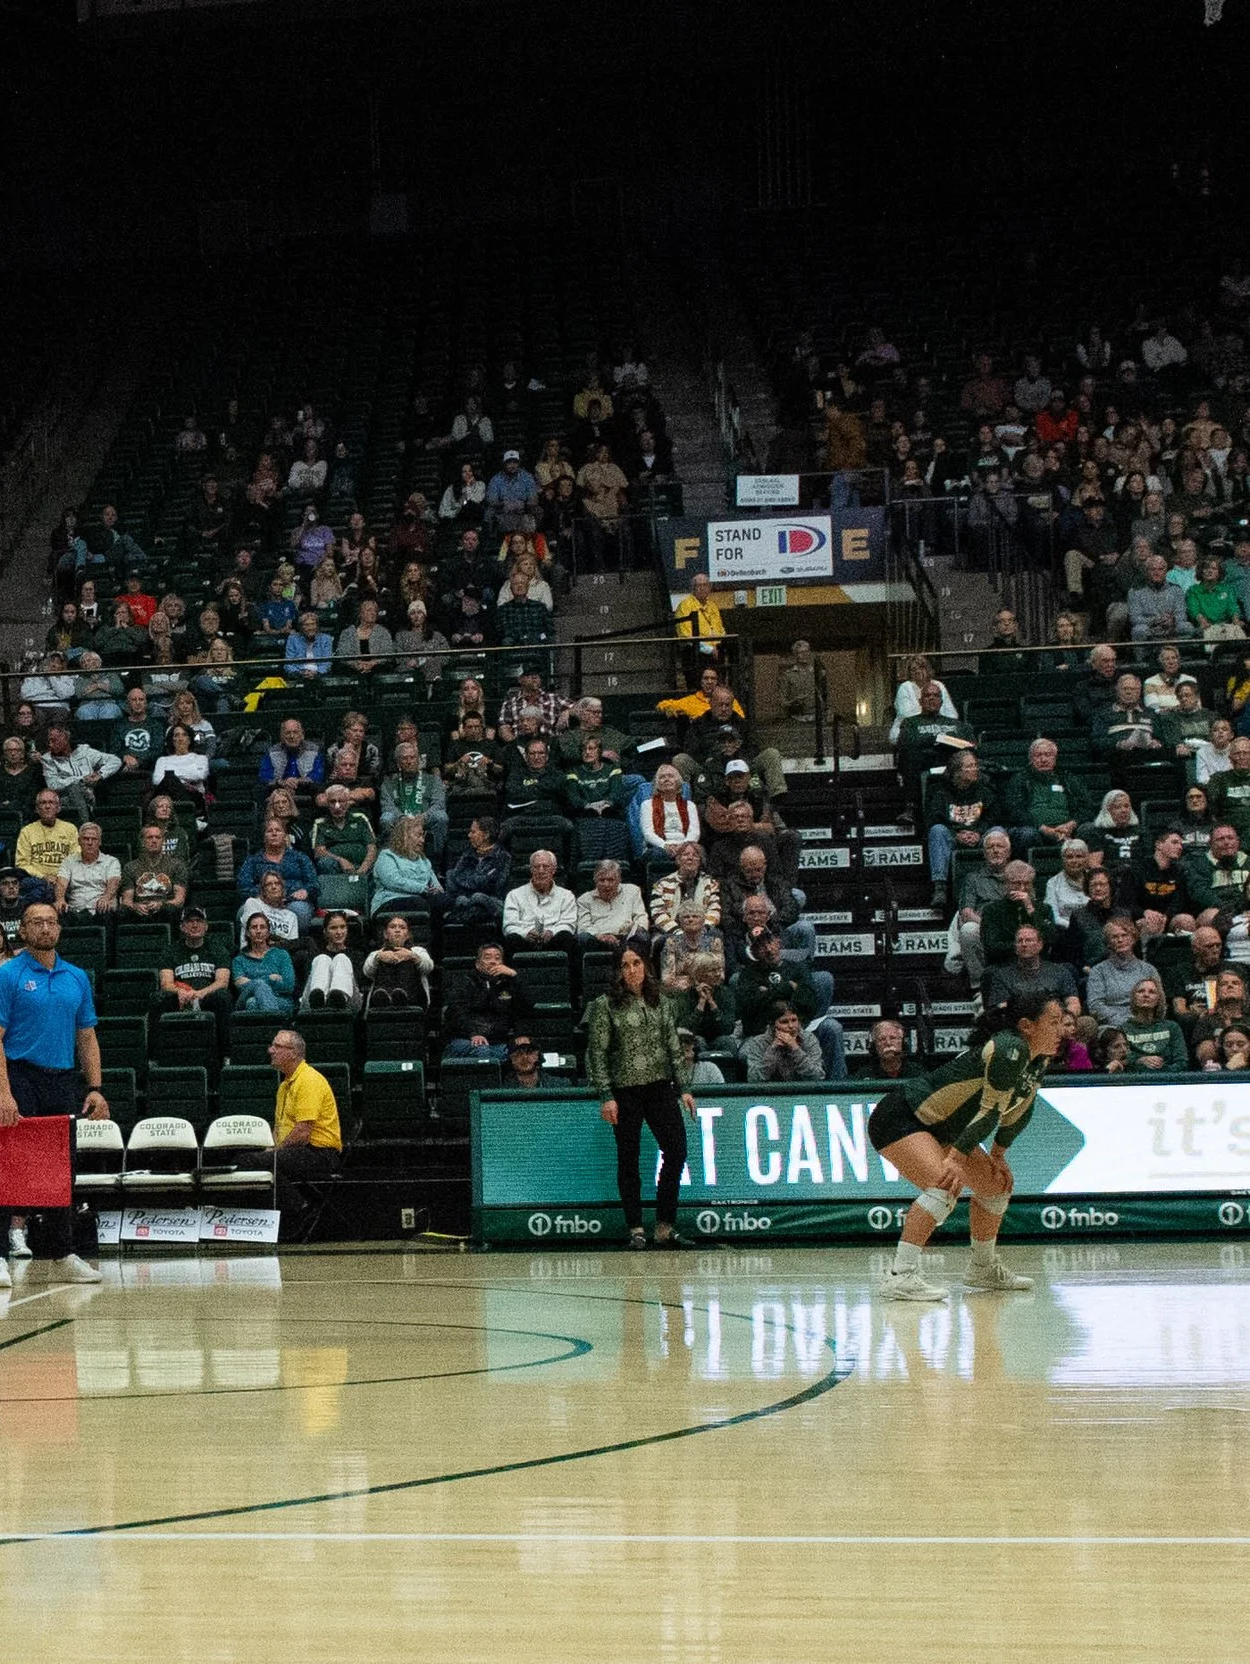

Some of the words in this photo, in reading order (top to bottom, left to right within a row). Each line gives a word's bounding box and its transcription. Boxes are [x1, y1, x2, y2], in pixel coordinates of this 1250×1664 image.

[715, 528, 761, 542] STAND
[842, 528, 870, 560] E
[674, 538, 700, 569] F
[716, 548, 743, 560] FOR
[761, 588, 783, 604] EXIT
[30, 841, 70, 855] COLORADO
[39, 853, 63, 863] STATE
[879, 853, 920, 864] RAMS
[818, 941, 862, 953] RAMS
[906, 939, 948, 950] RAMS
[129, 1210, 194, 1226] Pedersen
[206, 1210, 272, 1226] Pedersen
[722, 1212, 771, 1231] fnbo
[1068, 1207, 1119, 1226] fnbo
[554, 1216, 602, 1234] fnbo
